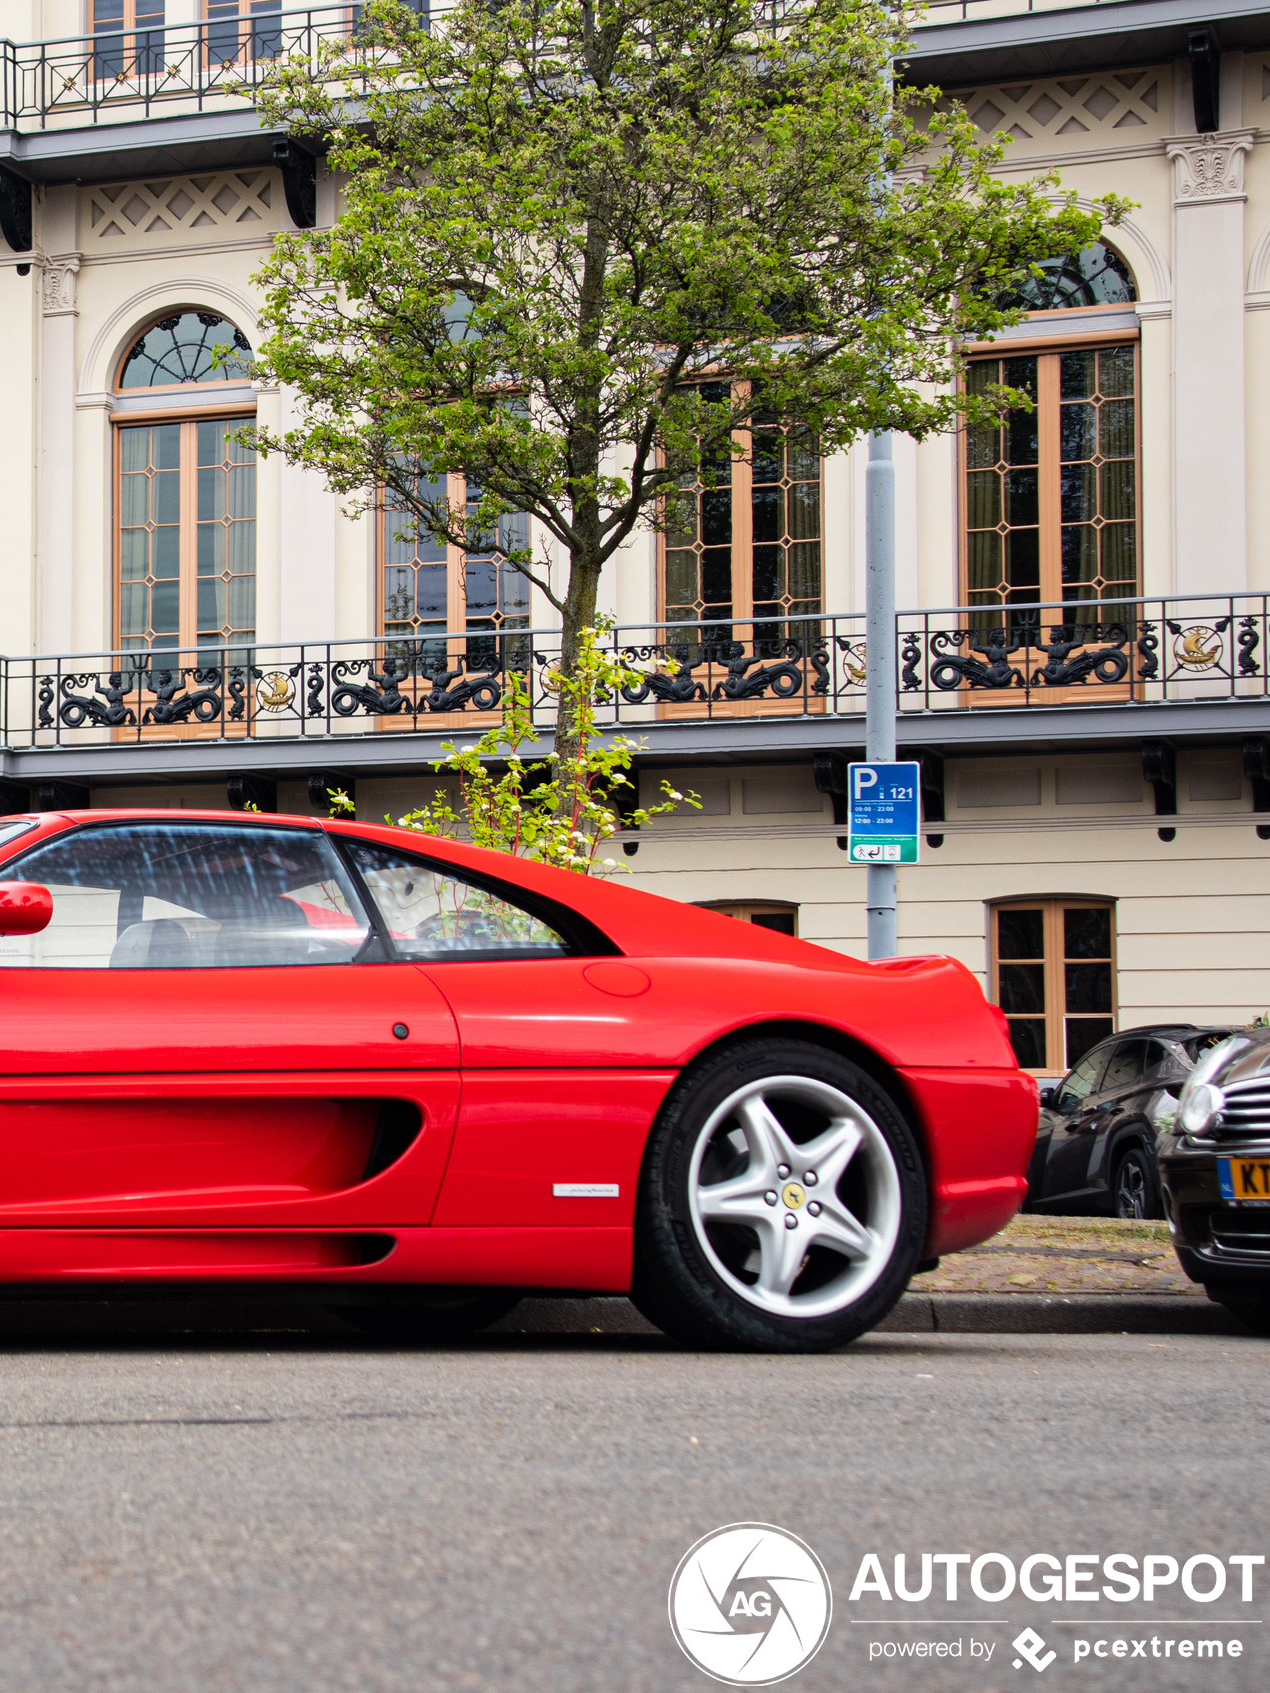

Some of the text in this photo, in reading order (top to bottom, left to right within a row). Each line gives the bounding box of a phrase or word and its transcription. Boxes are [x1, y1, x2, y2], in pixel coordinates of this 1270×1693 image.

[854, 768, 913, 799] P 121
[1241, 1163, 1270, 1194] KT
